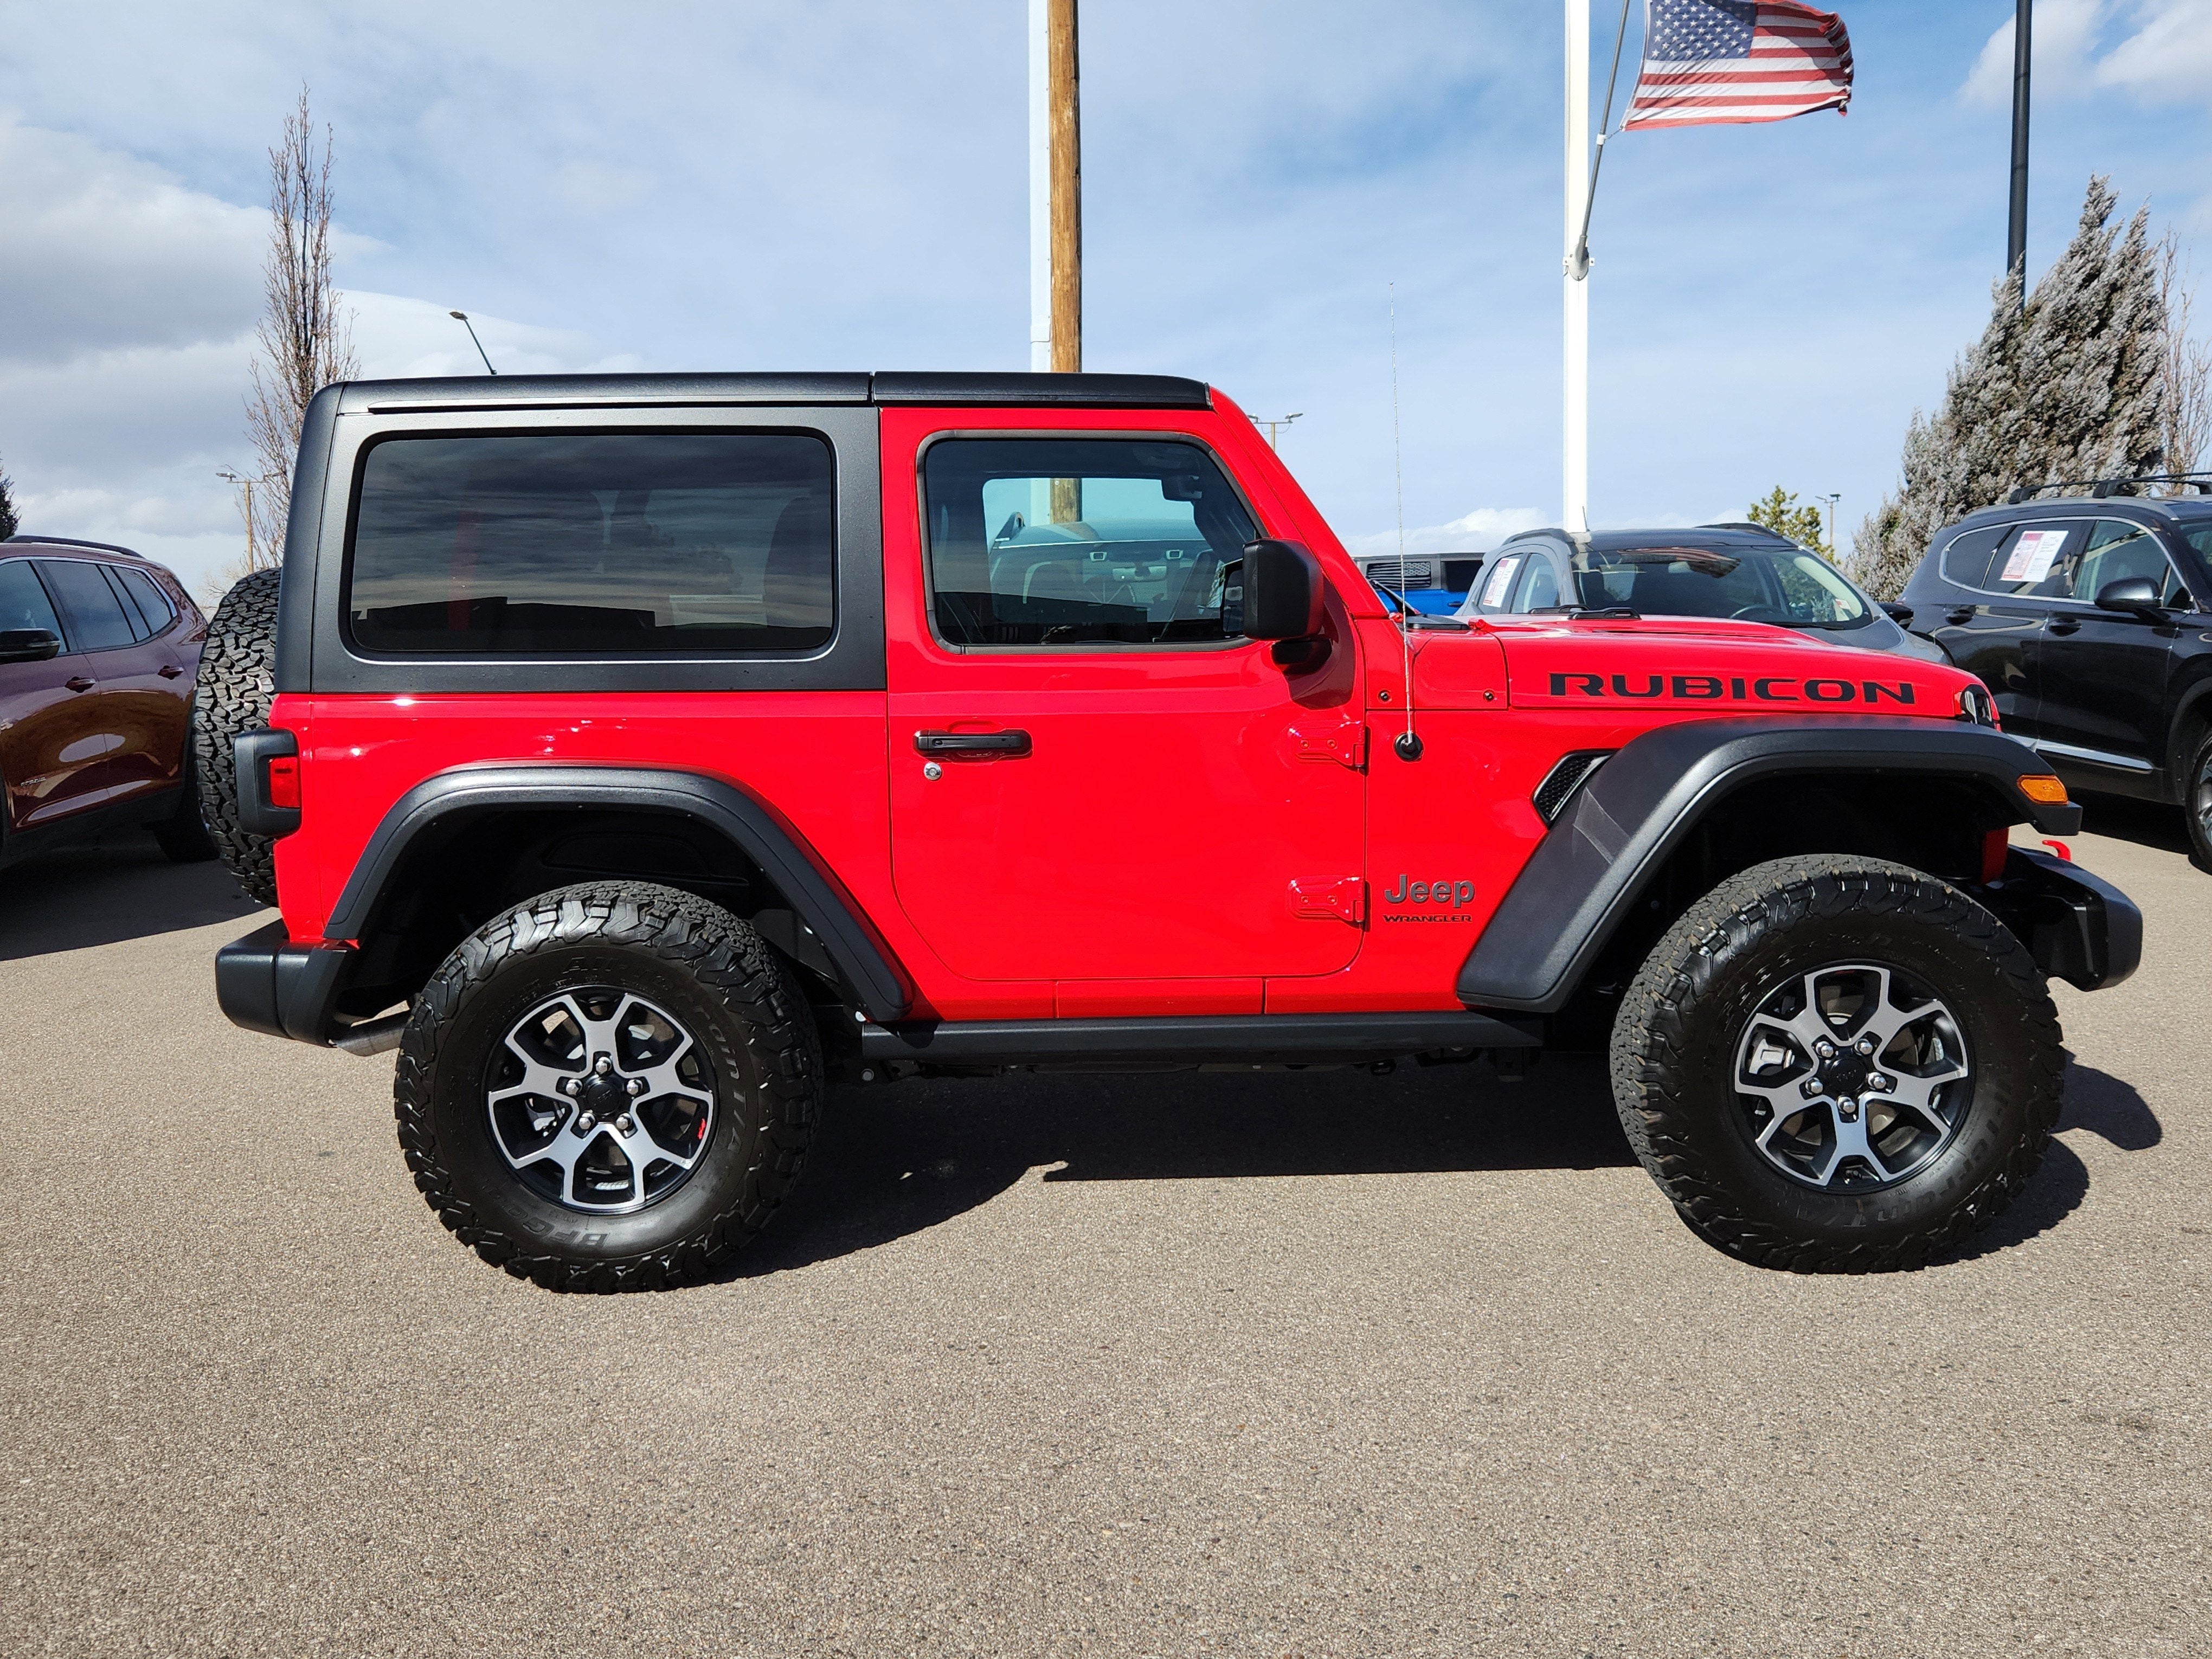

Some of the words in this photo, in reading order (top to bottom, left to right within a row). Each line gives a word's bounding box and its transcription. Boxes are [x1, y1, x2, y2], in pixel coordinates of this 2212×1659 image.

[1548, 672, 1915, 704] RUBICON
[1385, 873, 1476, 908] Jeep
[1383, 915, 1474, 923] WRANGLER
